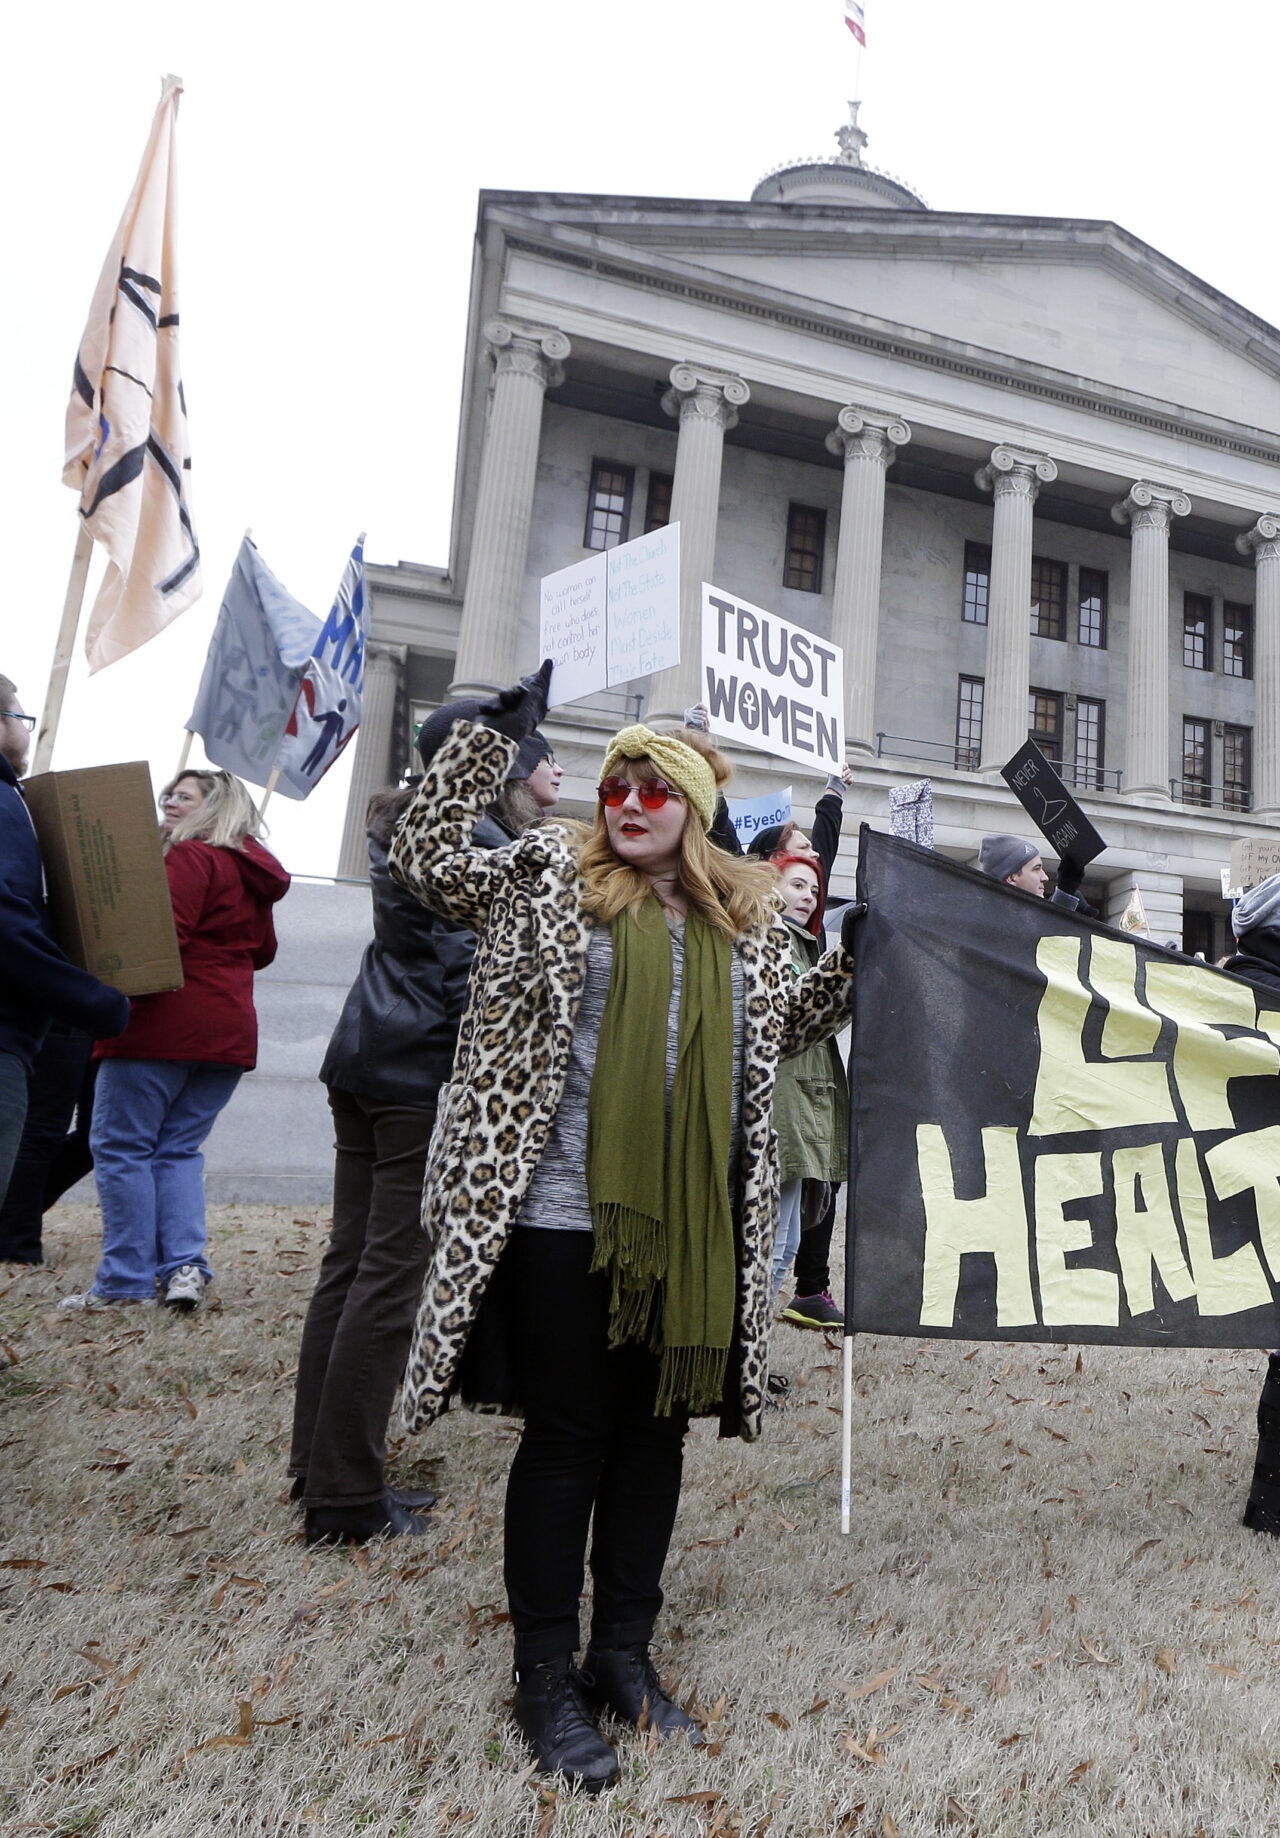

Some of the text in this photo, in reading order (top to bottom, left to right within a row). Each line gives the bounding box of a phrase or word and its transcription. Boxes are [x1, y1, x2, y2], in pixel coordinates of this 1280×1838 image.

[573, 642, 596, 667] body
[708, 595, 836, 697] TRUST
[706, 666, 839, 764] WOMEN
[1012, 758, 1040, 791] NEVER
[1052, 820, 1078, 851] AGAIN
